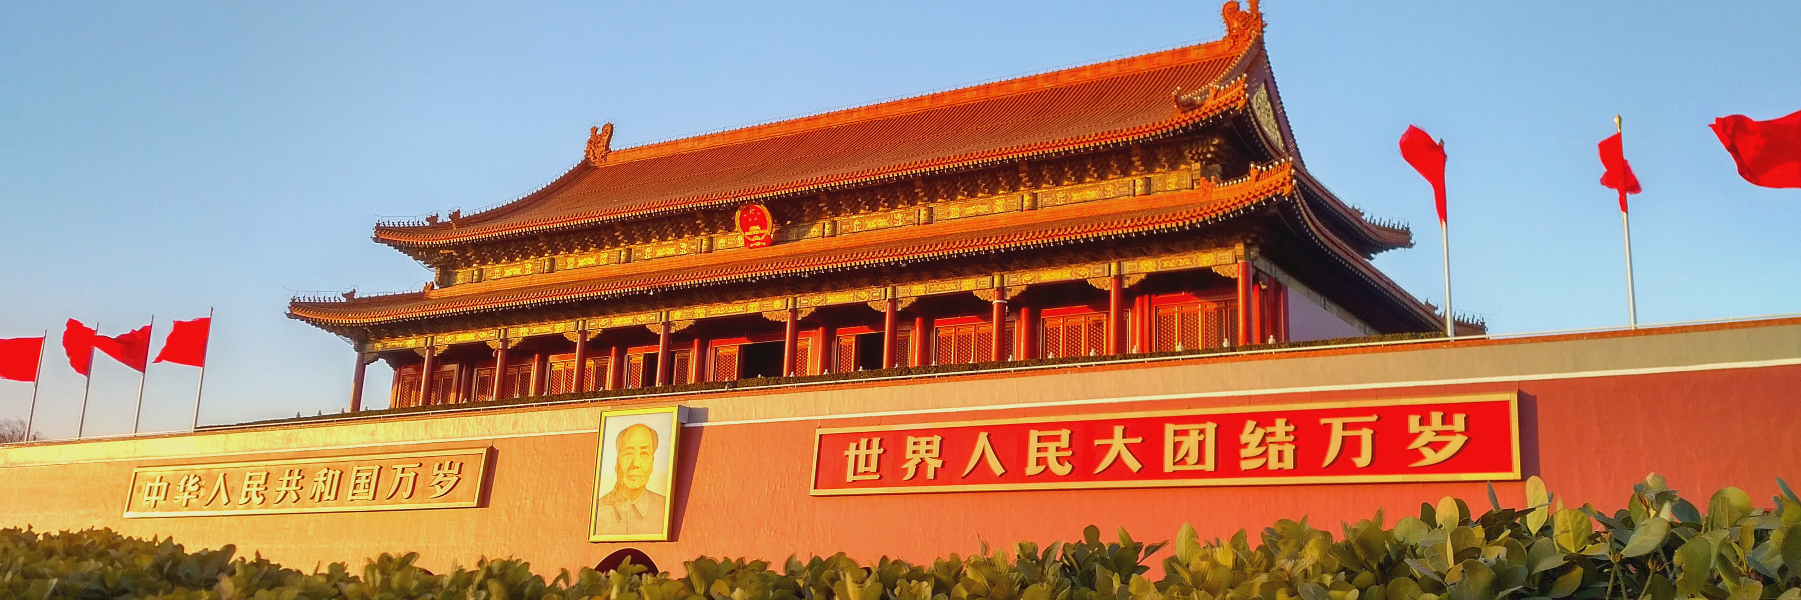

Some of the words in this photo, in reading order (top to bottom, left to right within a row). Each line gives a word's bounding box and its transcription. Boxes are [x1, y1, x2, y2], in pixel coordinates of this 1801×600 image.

[844, 411, 1471, 483] 世界人民大团结万岁
[143, 461, 464, 508] 中华人民共和国万岁
